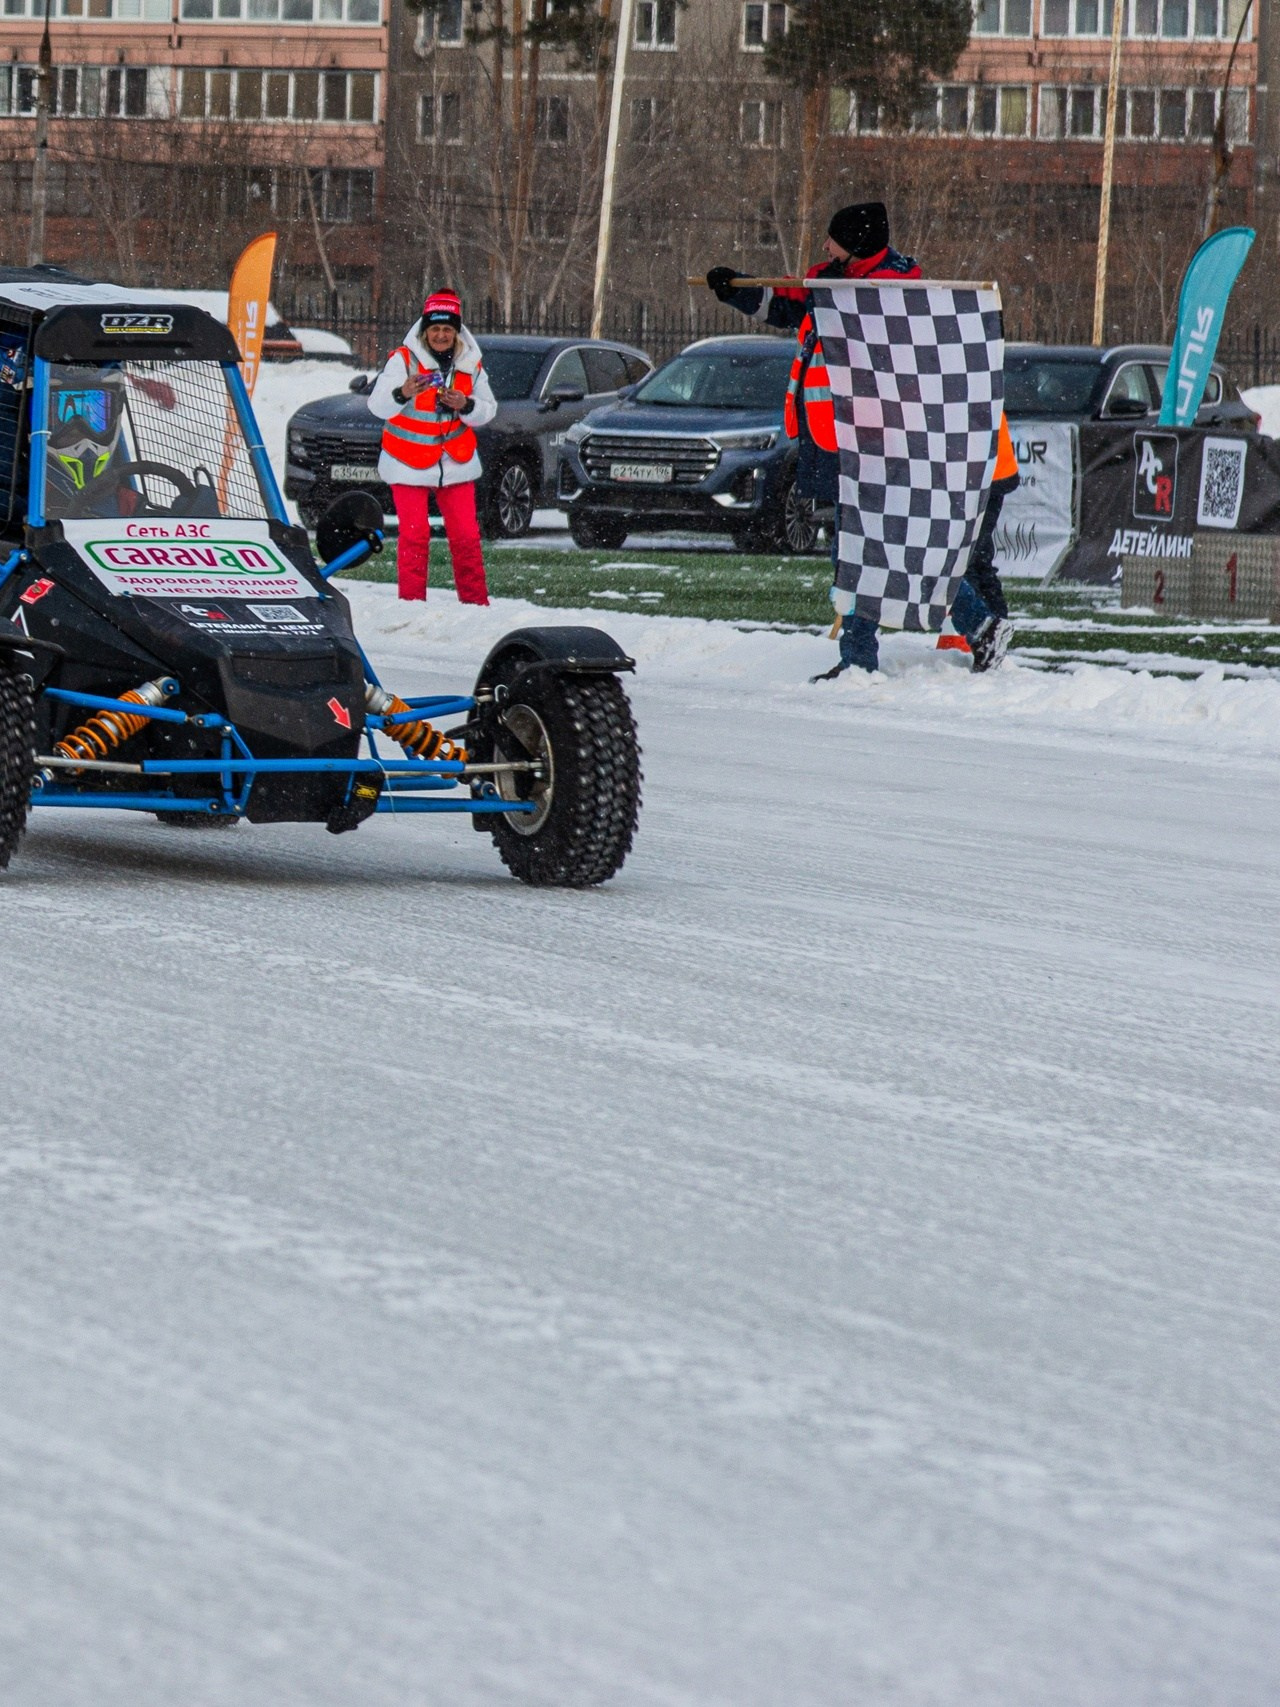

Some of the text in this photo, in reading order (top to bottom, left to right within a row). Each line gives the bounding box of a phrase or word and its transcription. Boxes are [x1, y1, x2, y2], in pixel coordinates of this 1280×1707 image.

[1011, 441, 1048, 465] UR
[126, 524, 211, 538] Сеть АЗС
[1107, 526, 1194, 558] ДЕТЕЙЛИНГ
[115, 575, 299, 587] Здоровое топливо
[1153, 570, 1165, 604] 2
[1225, 552, 1238, 603] 1
[134, 585, 299, 597] по честной цене!
